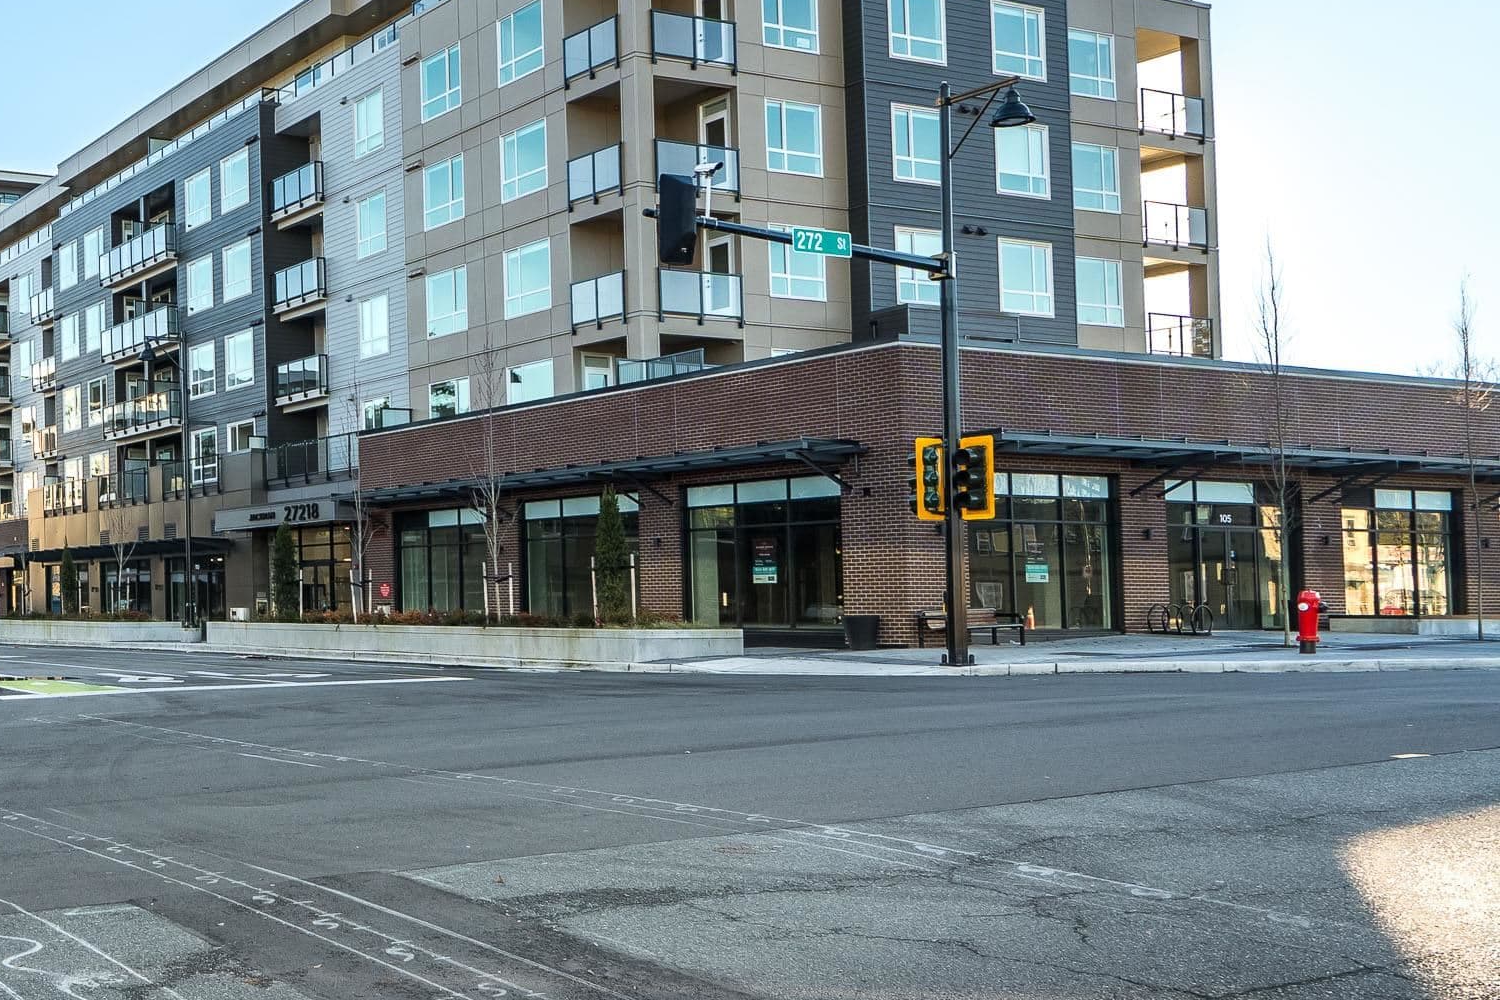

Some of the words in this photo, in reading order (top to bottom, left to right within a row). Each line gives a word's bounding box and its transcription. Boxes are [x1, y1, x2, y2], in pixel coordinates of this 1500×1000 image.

[797, 230, 824, 252] 272
[836, 236, 847, 251] St
[284, 503, 320, 521] 27218
[1219, 514, 1232, 524] 105
